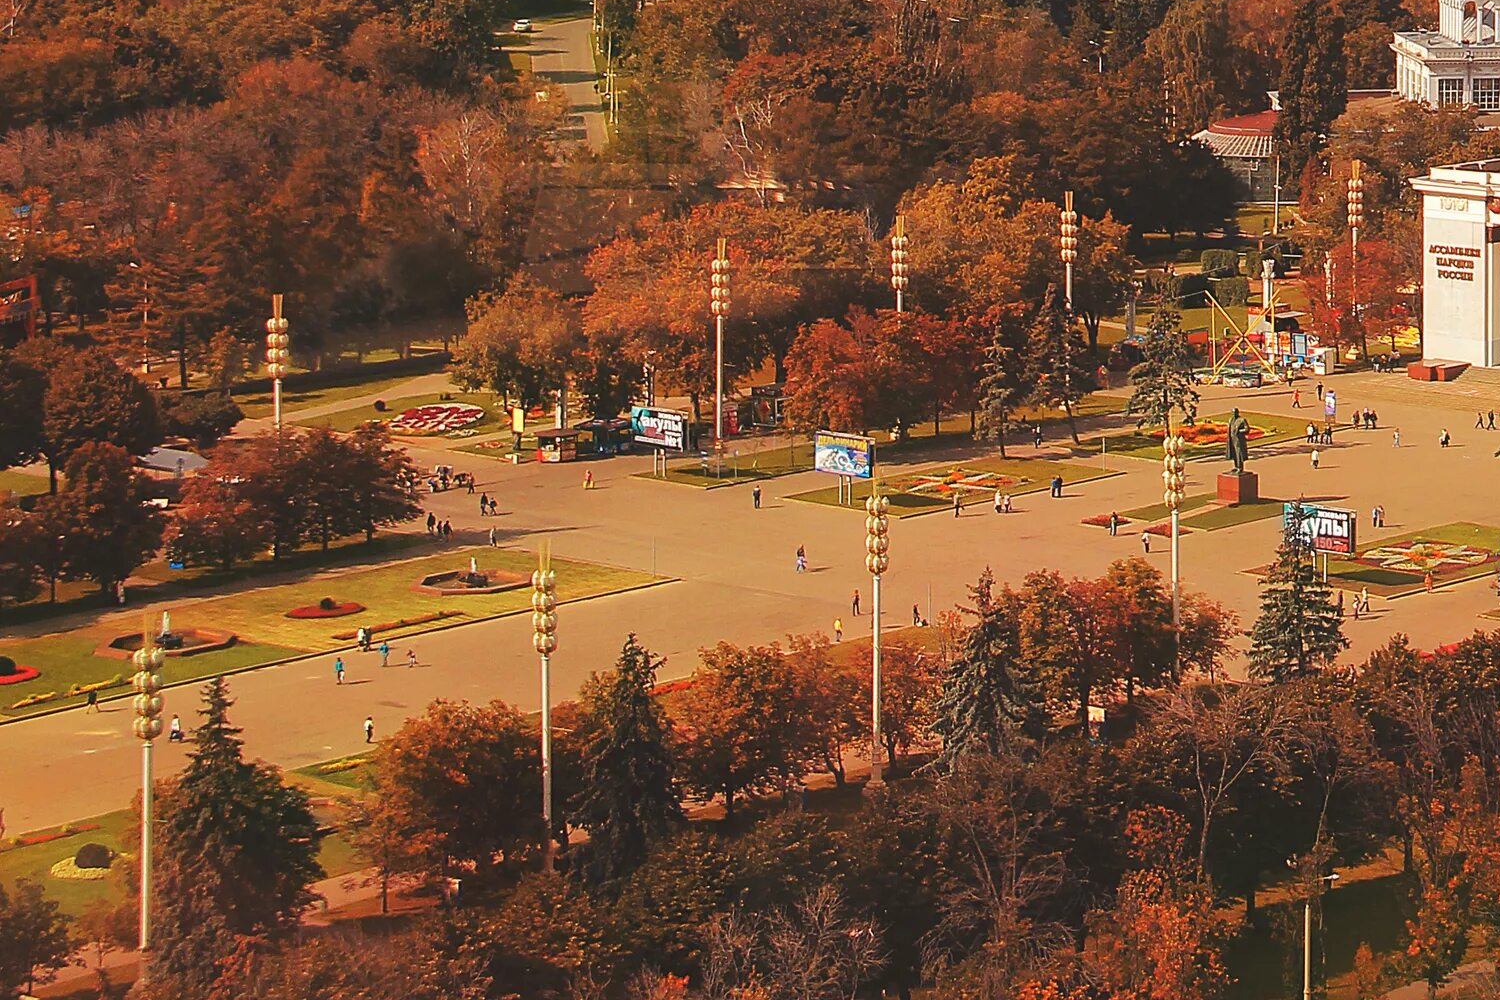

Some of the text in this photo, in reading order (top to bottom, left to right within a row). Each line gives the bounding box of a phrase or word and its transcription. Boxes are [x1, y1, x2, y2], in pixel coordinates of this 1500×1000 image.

[1429, 244, 1481, 258] АССАМБЛЕЯ
[1436, 257, 1474, 270] НАРОДОВ
[1438, 269, 1474, 282] РОССИИ
[640, 416, 683, 433] акулы
[664, 435, 683, 450] №1
[1314, 538, 1333, 550] 150
